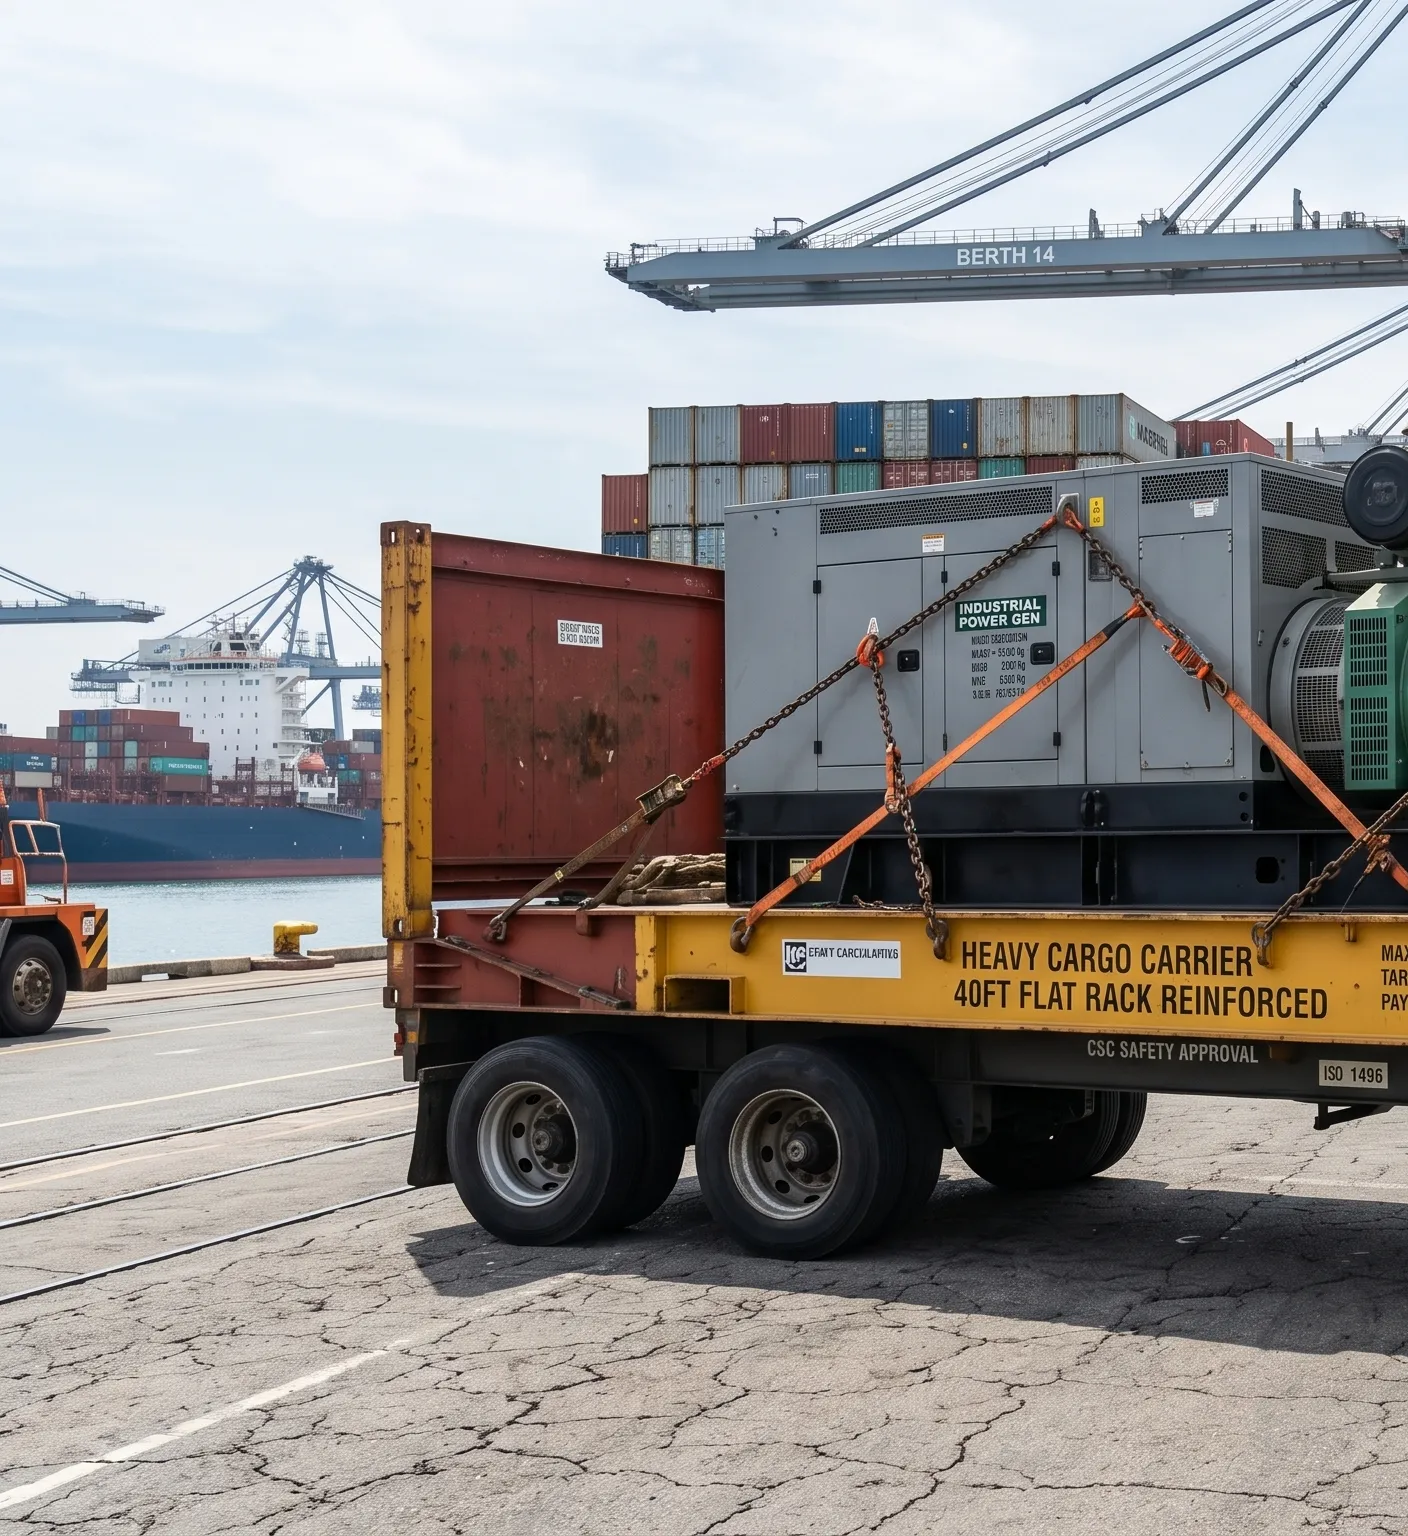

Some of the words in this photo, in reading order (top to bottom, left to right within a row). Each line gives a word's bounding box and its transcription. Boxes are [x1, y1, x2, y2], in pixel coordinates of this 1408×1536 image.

[957, 246, 1026, 266] BERTH
[1033, 245, 1055, 263] 14
[960, 598, 1041, 615] INDUSTRIAL
[960, 614, 1008, 629] POWER
[1012, 612, 1040, 625] GEN
[961, 941, 1040, 971] HEAVY
[1047, 942, 1132, 974] CARGO
[1140, 944, 1254, 977] CARRIER
[953, 979, 1012, 1009] 40FT
[1019, 980, 1077, 1011] FLAT
[1085, 982, 1153, 1014] RACK
[1161, 985, 1328, 1019] REINFORCED
[1087, 1039, 1115, 1058] CSC
[1119, 1040, 1175, 1060] SAFETY
[1179, 1043, 1259, 1063] APPROVAL
[1324, 1065, 1343, 1081] ISO
[1350, 1067, 1383, 1084] 1496
